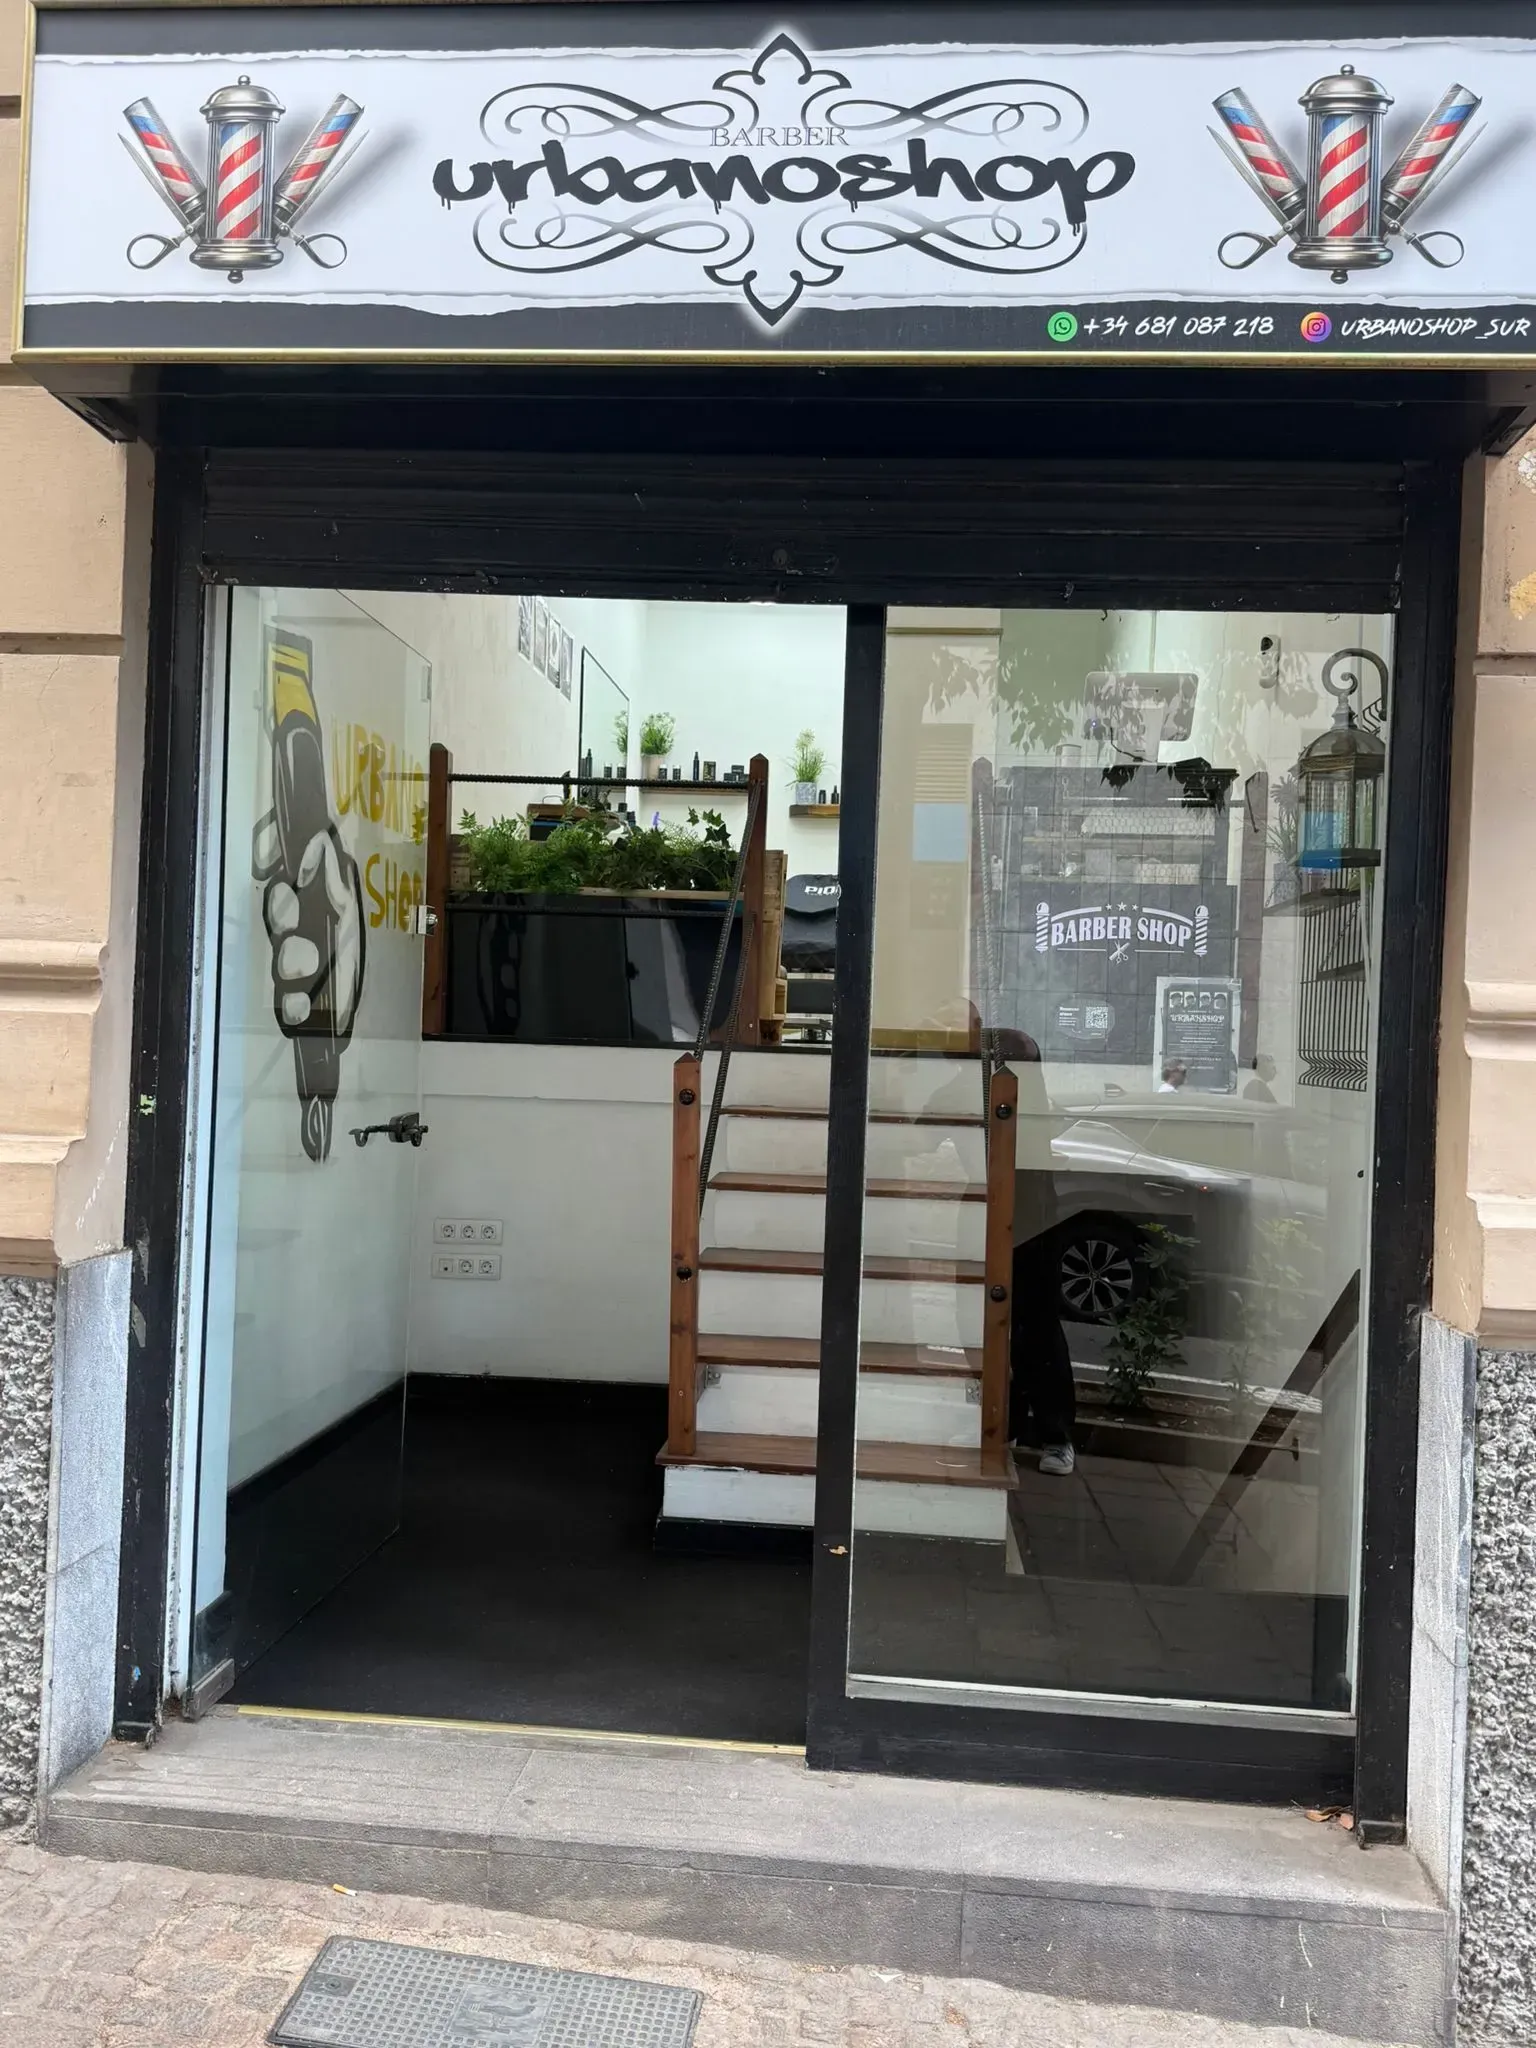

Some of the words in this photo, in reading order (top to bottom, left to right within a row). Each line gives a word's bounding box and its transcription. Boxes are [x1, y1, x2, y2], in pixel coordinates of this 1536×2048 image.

[709, 125, 850, 147] BARBER
[432, 138, 1136, 237] urbanoshop
[1083, 316, 1128, 336] +34
[1135, 316, 1176, 336] 681
[1183, 316, 1227, 336] 087
[1233, 316, 1275, 336] 218
[804, 885, 838, 896] PIO
[1051, 916, 1132, 946] BARBER
[1137, 917, 1192, 948] SHOP
